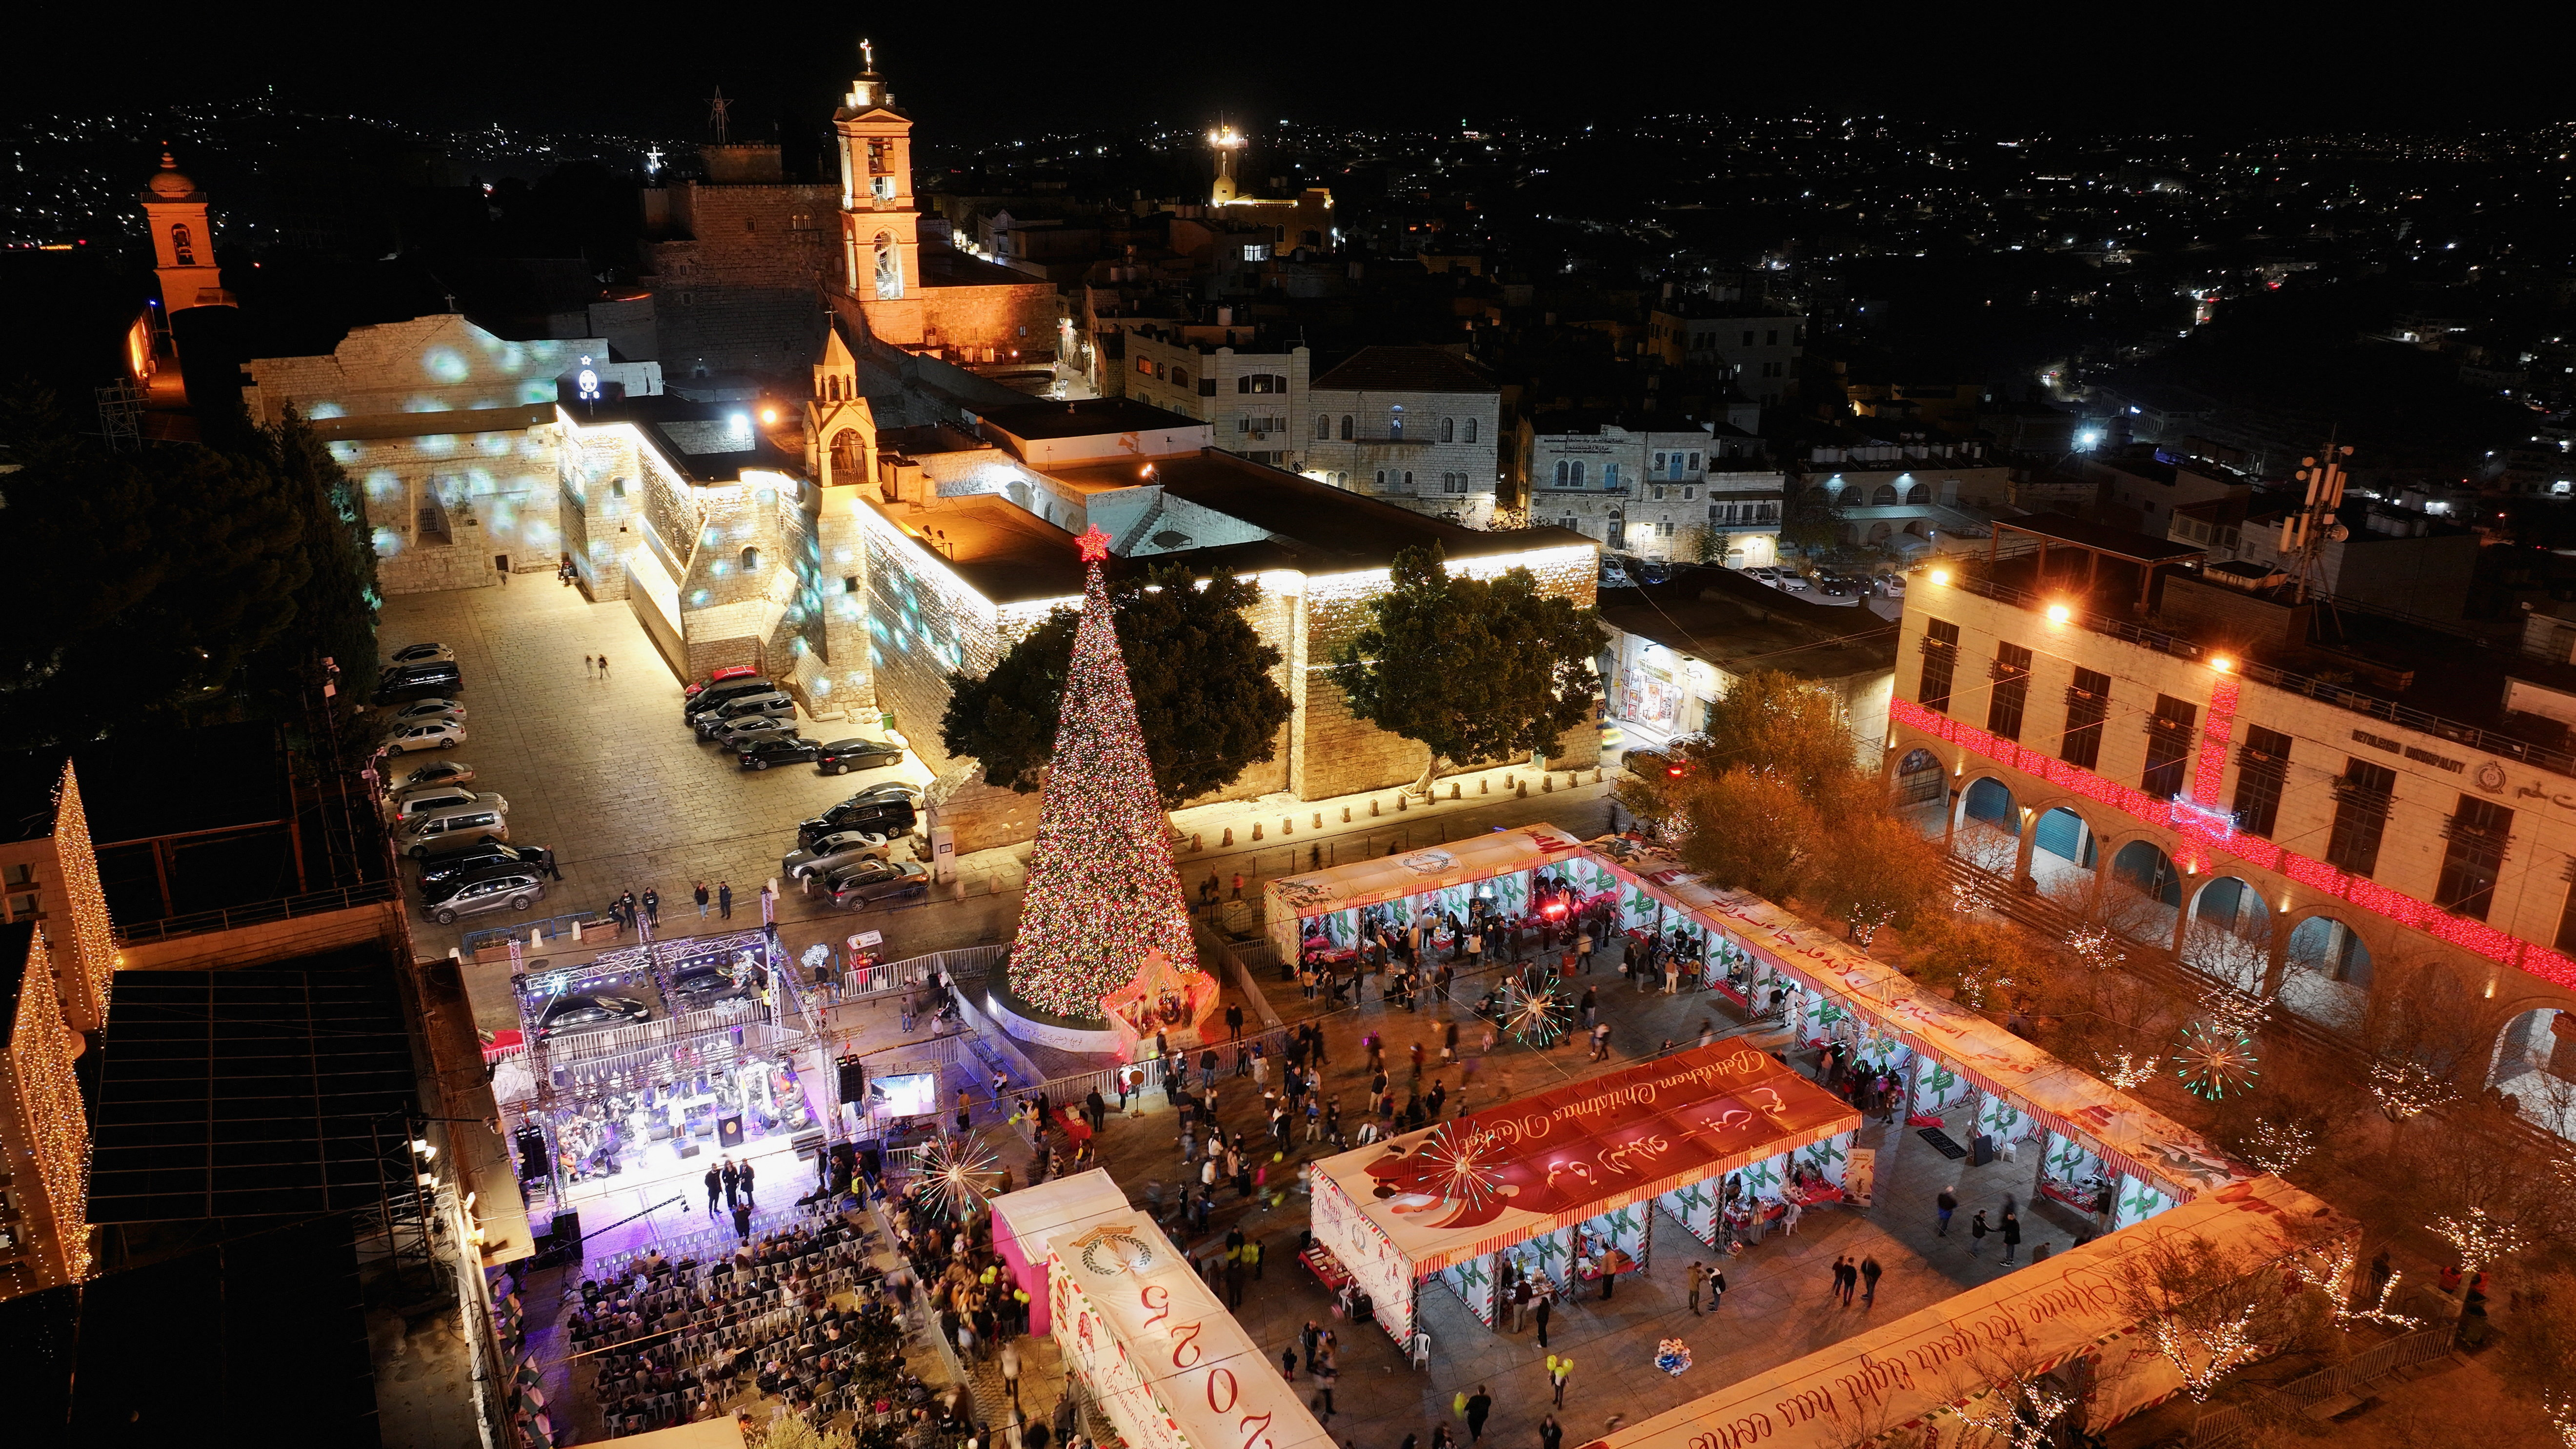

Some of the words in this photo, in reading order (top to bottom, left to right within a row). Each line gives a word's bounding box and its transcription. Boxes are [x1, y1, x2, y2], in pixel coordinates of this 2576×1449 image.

[2352, 729, 2401, 754] BETHLEHEM
[2404, 746, 2465, 774] MUNICIPALITY
[1661, 1050, 1765, 1090] Bethlehem
[1552, 1083, 1656, 1121] Christmas
[1459, 1114, 1550, 1155] Market
[1548, 1160, 1598, 1189] سوق
[1597, 1134, 1669, 1175] الميلاد
[1700, 1109, 1752, 1133] بيت
[1751, 1087, 1787, 1120] لحم
[1320, 1188, 1343, 1220] Merry
[1373, 1295, 1395, 1324] Market
[1975, 1301, 2028, 1347] for
[1141, 1286, 1273, 1449] 2025
[1905, 1319, 1979, 1375] your
[1102, 1368, 1138, 1426] Bethlehem
[1835, 1354, 1916, 1414] light
[1776, 1386, 1842, 1429] has
